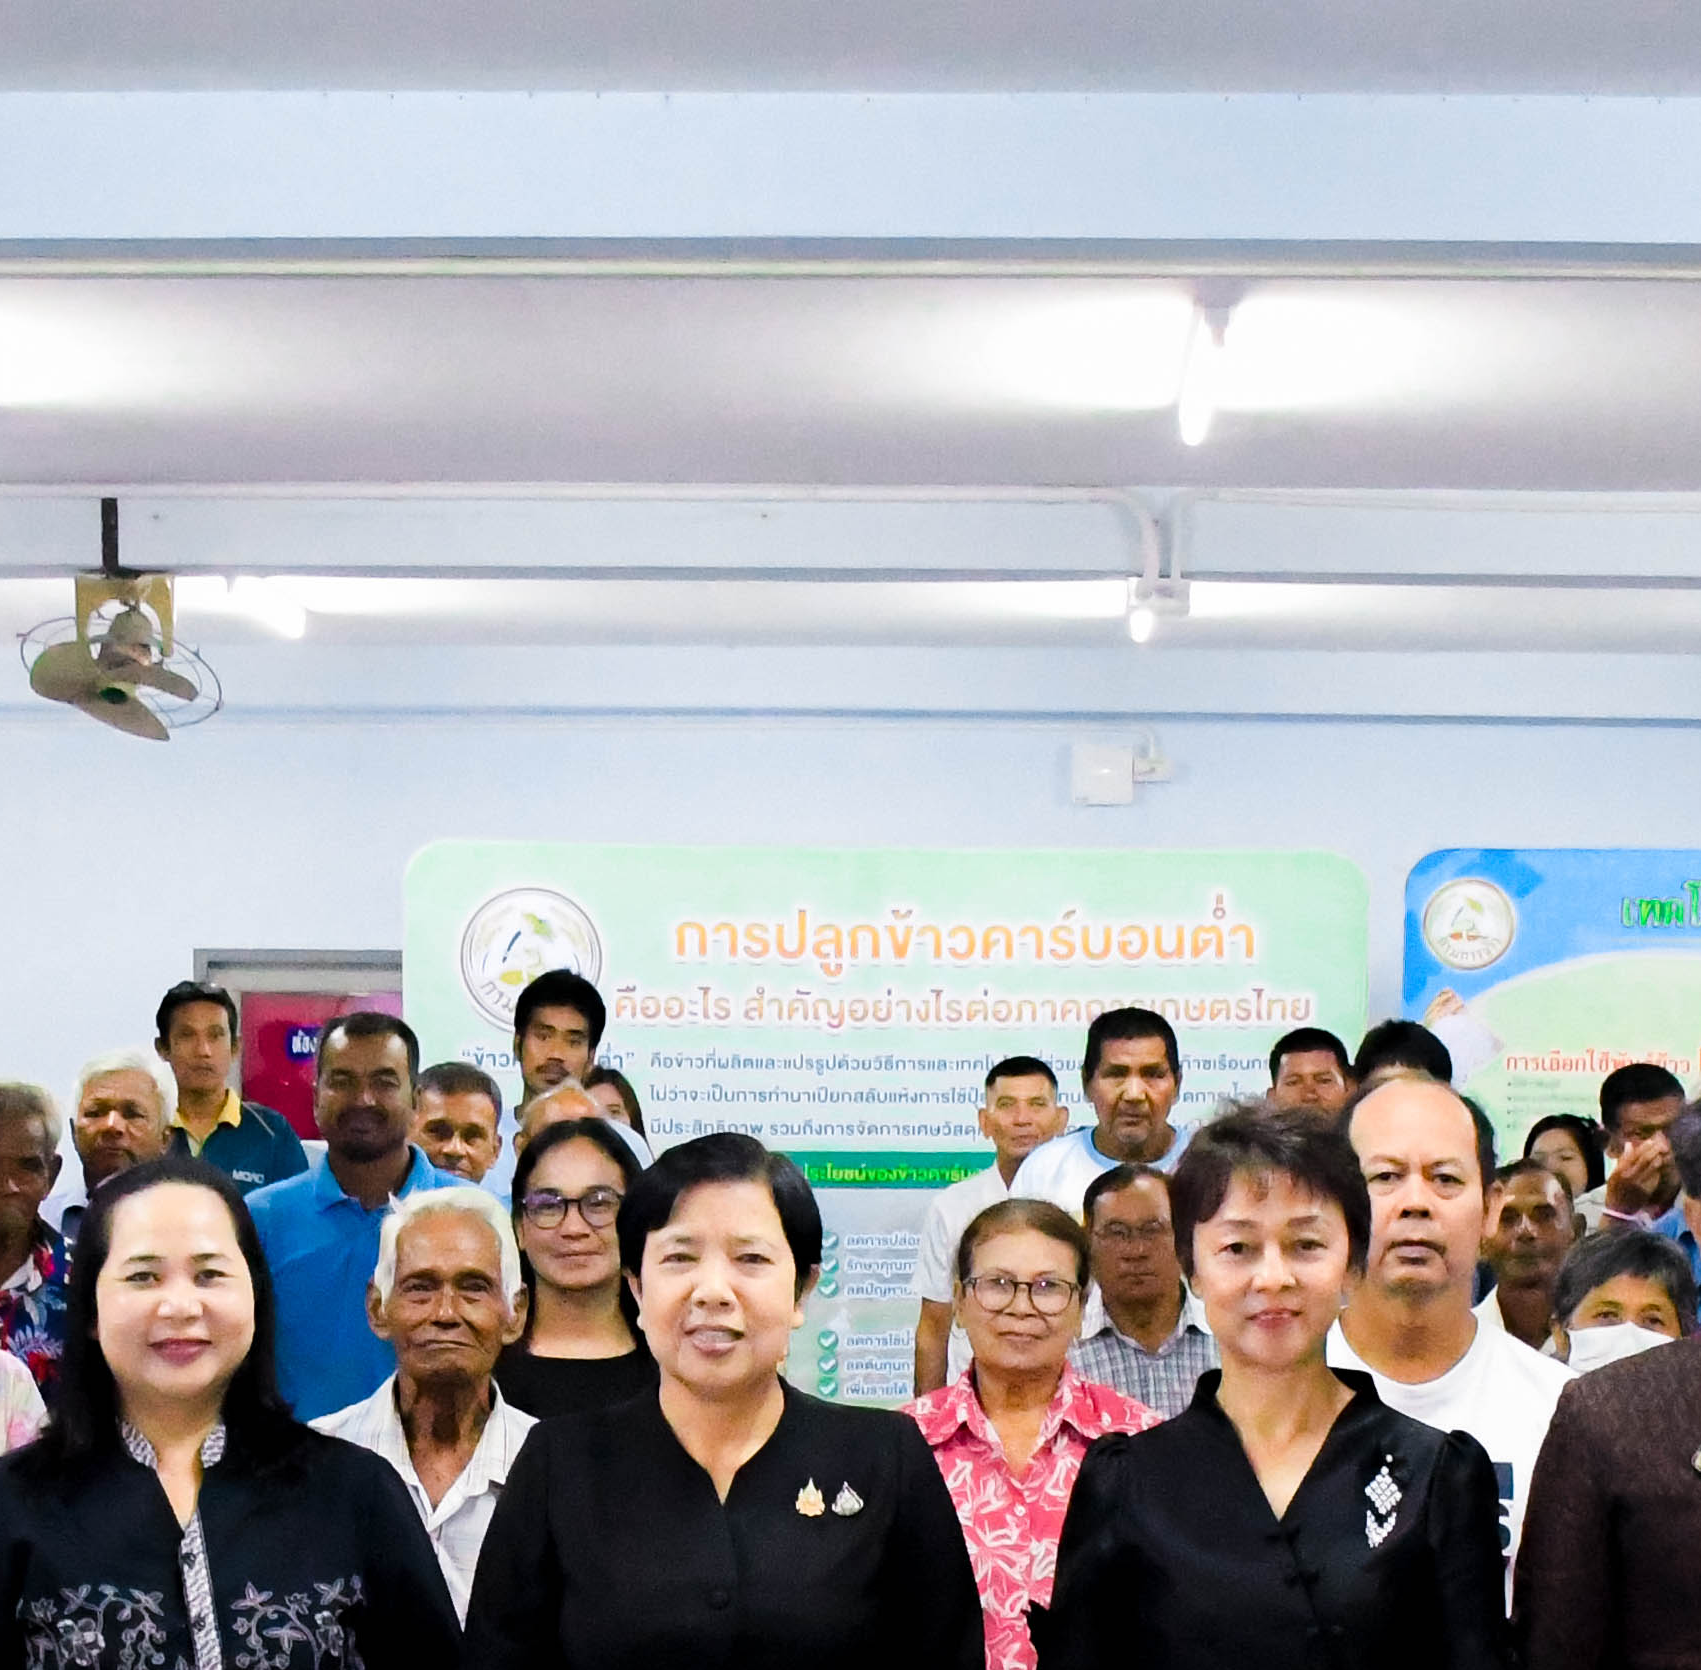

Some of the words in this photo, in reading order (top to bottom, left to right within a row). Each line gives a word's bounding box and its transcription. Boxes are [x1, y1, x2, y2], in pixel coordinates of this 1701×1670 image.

[675, 893, 1255, 977] การปลูกข้าวคาร์บอนต่ำ
[614, 986, 732, 1019] คืออะไร
